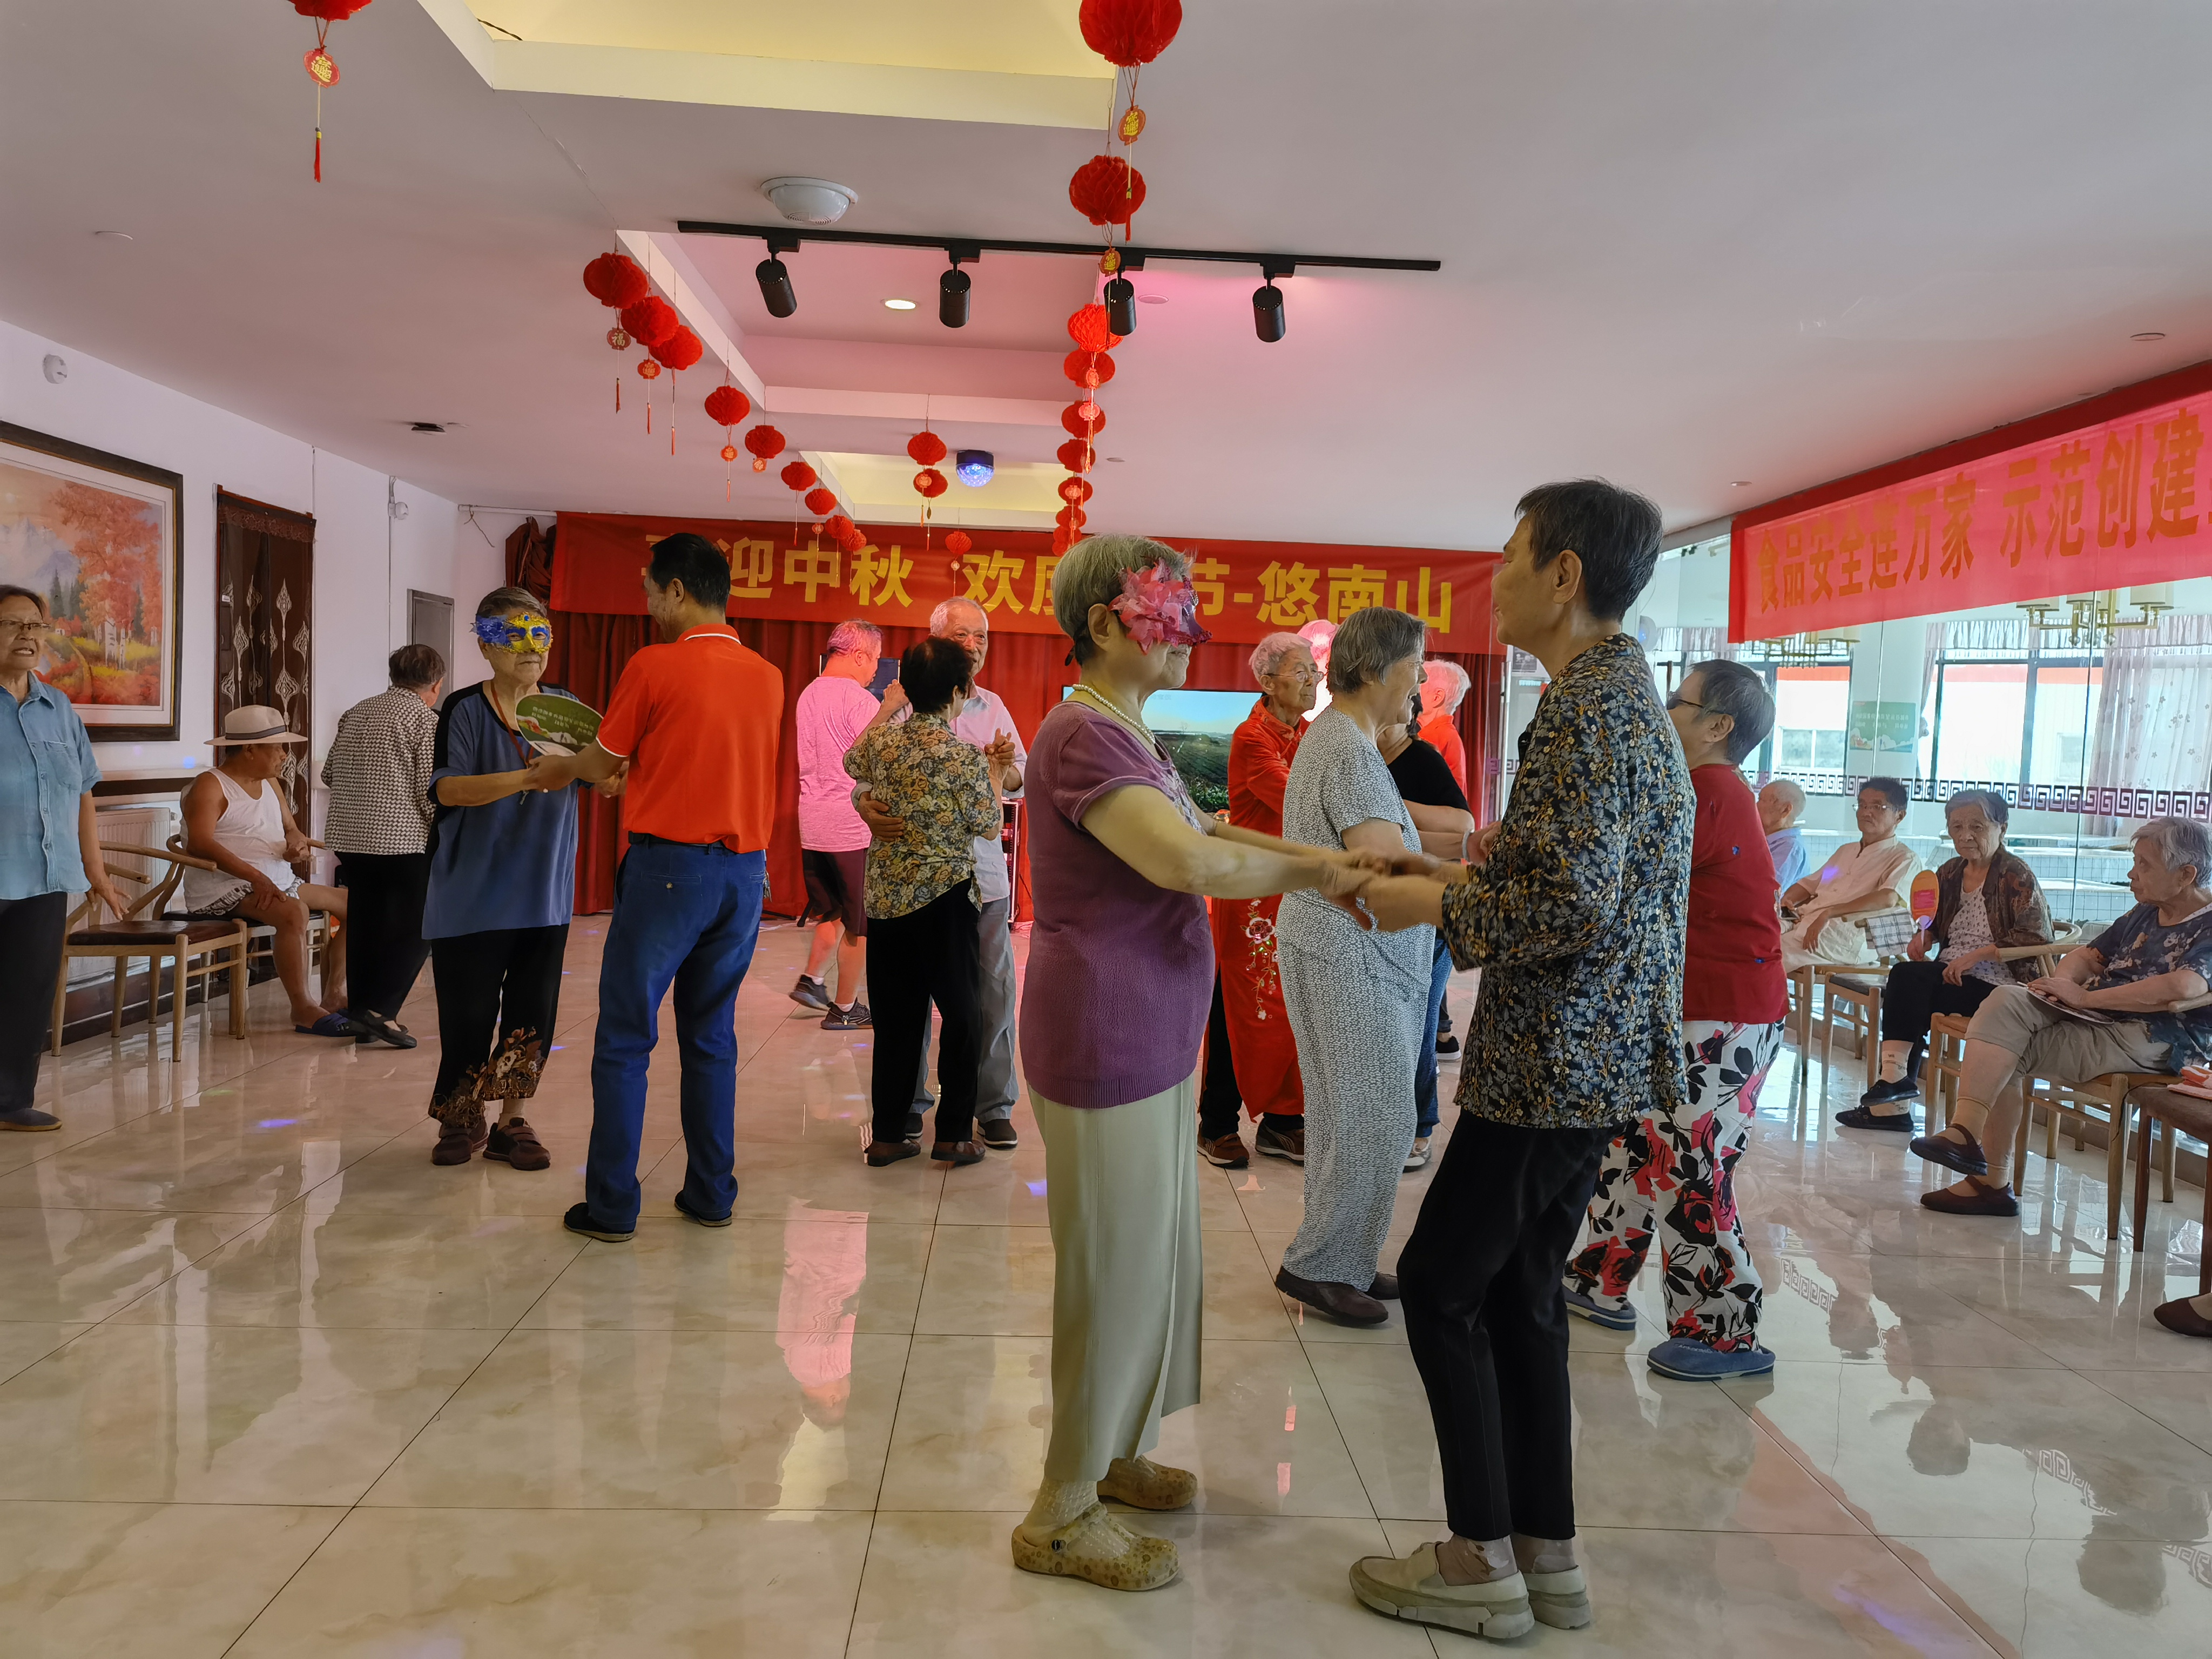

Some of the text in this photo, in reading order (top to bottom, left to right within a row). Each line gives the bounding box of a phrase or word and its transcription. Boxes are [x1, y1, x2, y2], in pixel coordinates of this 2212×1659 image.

[611, 332, 625, 346] 福
[2000, 407, 2212, 568] 示范创建
[640, 533, 914, 608] 迎中秋
